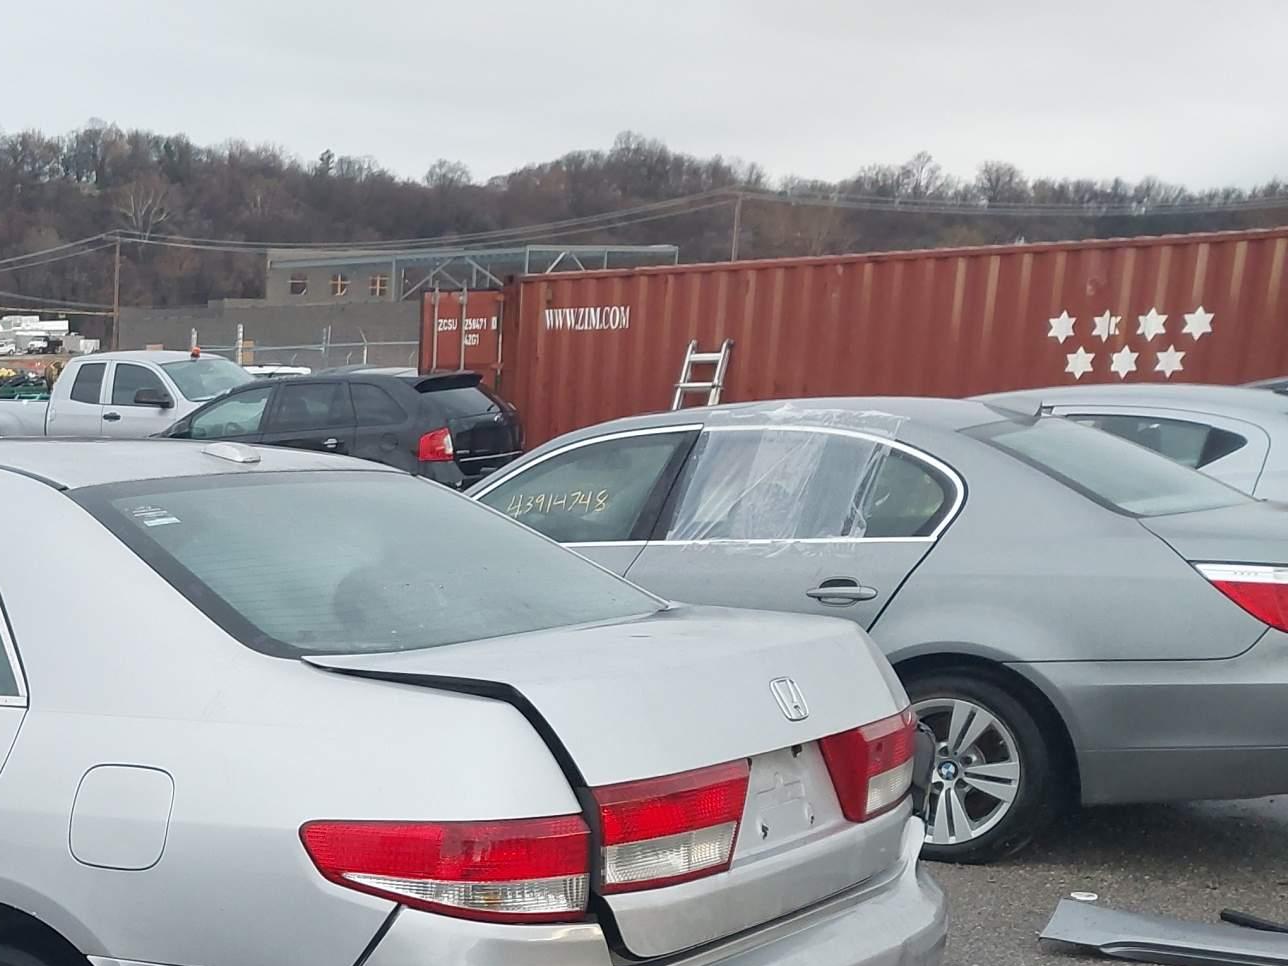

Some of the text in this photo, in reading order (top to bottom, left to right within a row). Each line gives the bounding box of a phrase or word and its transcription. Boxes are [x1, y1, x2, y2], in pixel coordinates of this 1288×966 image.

[438, 318, 458, 332] ZCSU
[545, 306, 630, 330] WWW.ZIM.COM
[507, 489, 609, 518] 43914748
